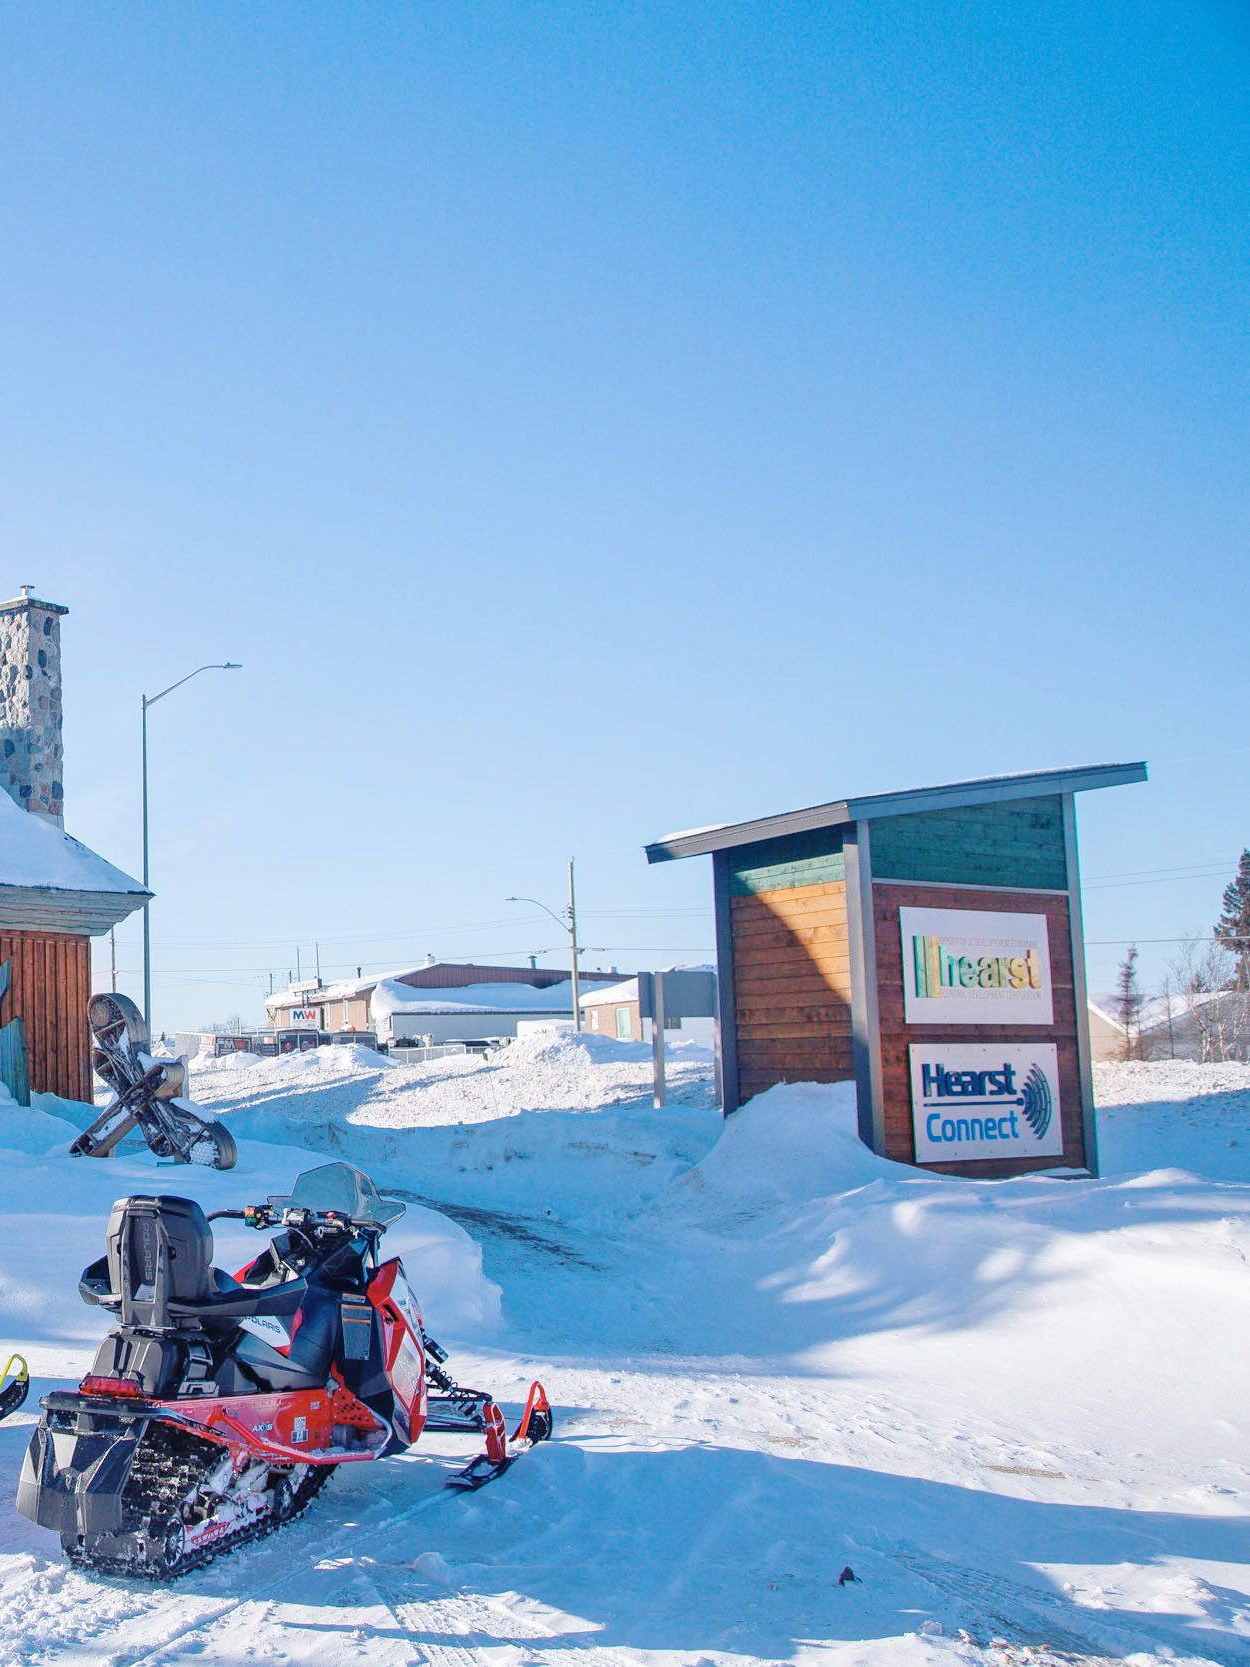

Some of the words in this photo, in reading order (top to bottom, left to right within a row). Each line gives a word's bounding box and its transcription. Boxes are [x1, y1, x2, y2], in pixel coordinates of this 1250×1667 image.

[938, 945, 1042, 989] hearst
[293, 1010, 317, 1020] MW
[921, 1063, 1018, 1098] Hearst
[926, 1110, 1020, 1143] Connect
[141, 1223, 153, 1281] POLARIS
[244, 1316, 281, 1334] POLARIS
